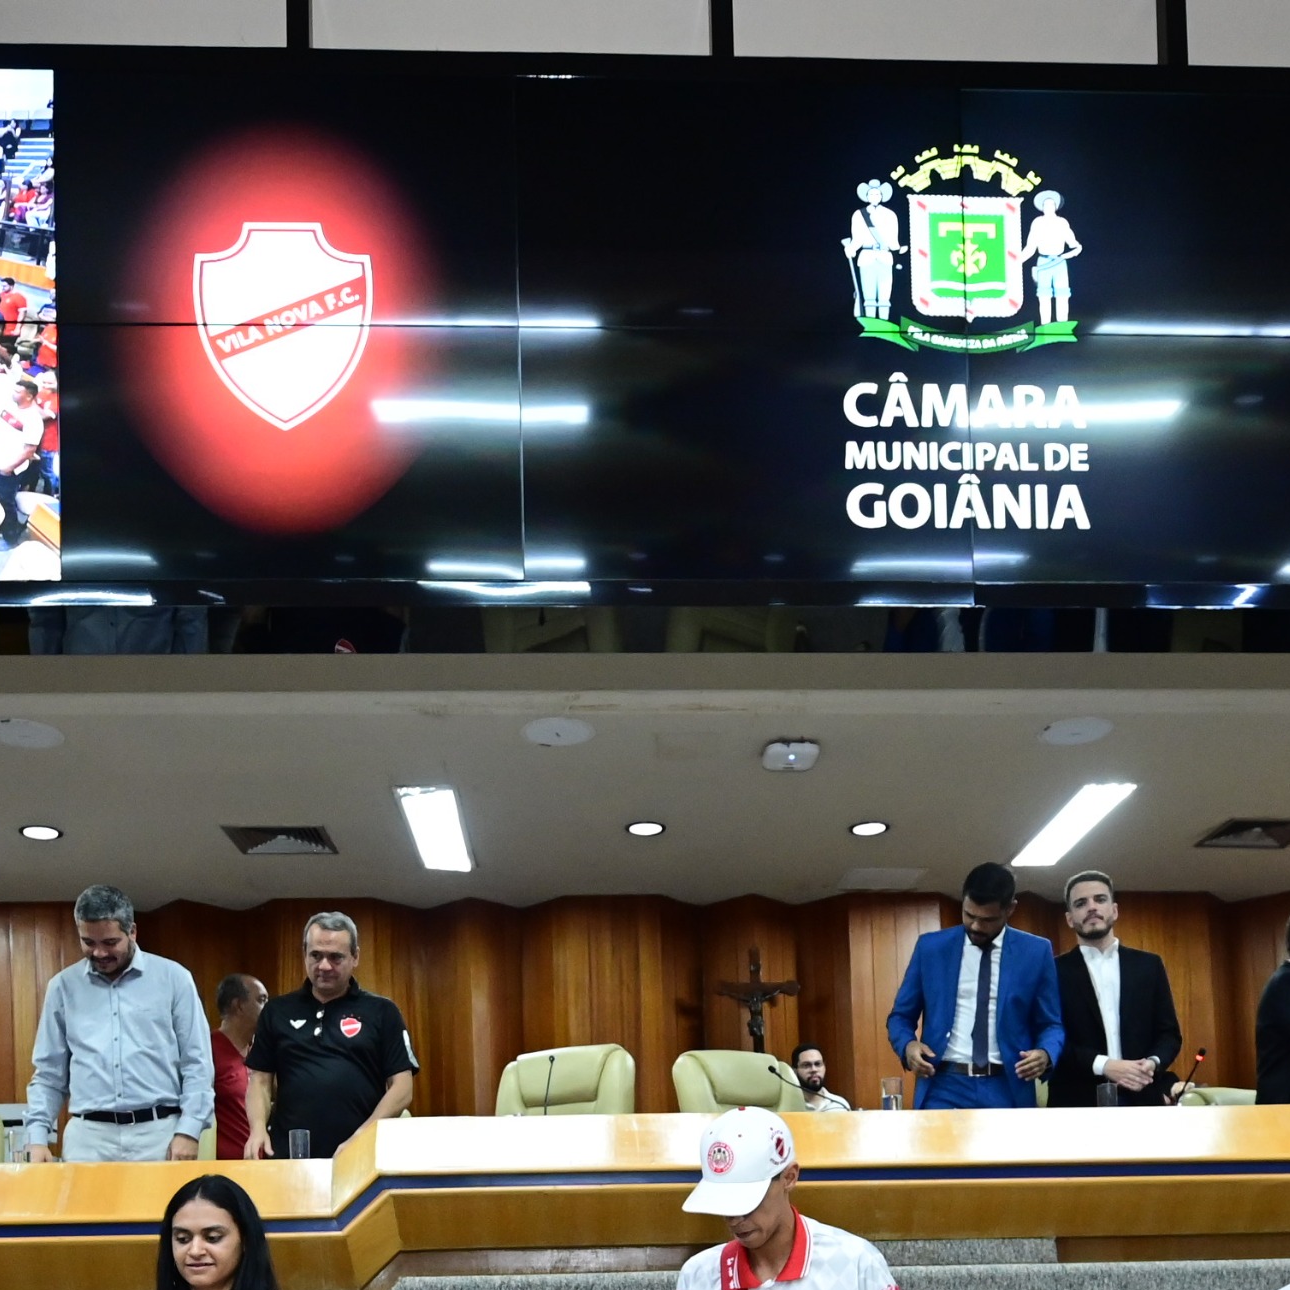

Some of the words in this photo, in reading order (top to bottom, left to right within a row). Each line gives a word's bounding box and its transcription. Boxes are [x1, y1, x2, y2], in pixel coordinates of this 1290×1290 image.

[215, 325, 264, 353] VILA
[263, 300, 325, 337] NOVA
[323, 286, 360, 312] F.C.
[842, 371, 1088, 429] CÂMARA
[844, 440, 1040, 472] MUNICIPAL
[1043, 442, 1090, 472] DE
[845, 473, 1092, 530] GOIÂNIA
